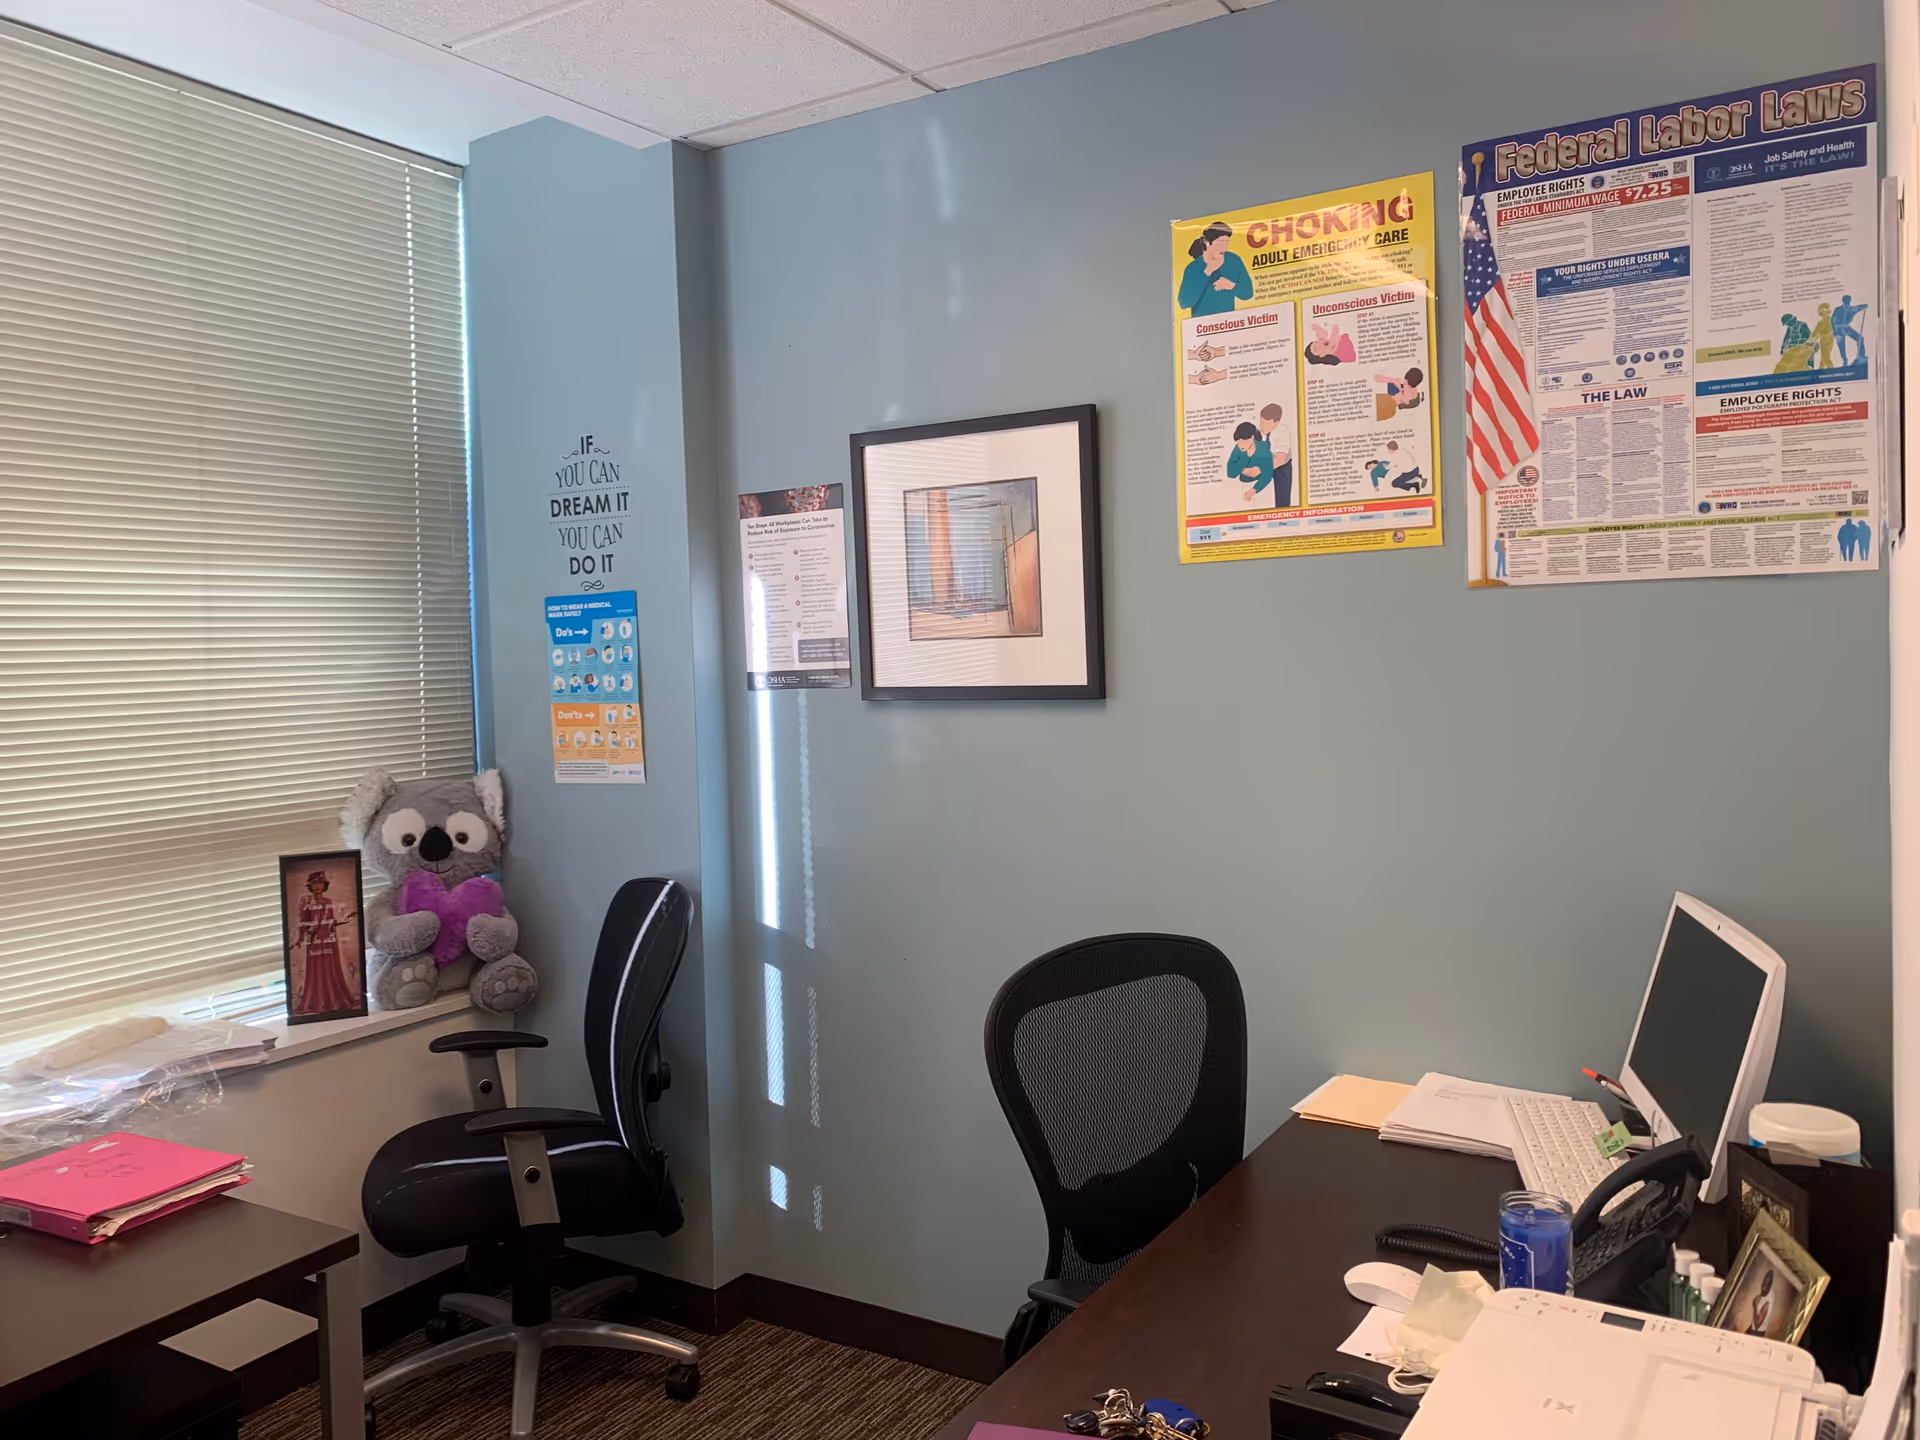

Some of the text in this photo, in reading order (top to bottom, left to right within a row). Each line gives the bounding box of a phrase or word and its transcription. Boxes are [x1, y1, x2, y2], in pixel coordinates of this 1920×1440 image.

[1496, 117, 1630, 183] Federal
[1639, 101, 1752, 156] Labor
[1761, 79, 1866, 133] Laws
[1764, 140, 1855, 163] Job Safety and Health
[1765, 151, 1854, 173] IT'S THE LAW!
[1497, 177, 1585, 202] EMPLOYEE RIGHTS
[1625, 181, 1671, 200] $7.25
[1501, 190, 1620, 221] FEDERAL MINIMUM WAGE
[1246, 195, 1414, 249] CHOKING
[1252, 249, 1288, 267] ADULT
[1292, 235, 1370, 260] EMERGENCY
[1375, 228, 1409, 245] CARE
[1554, 251, 1670, 277] YOUR RIGHTS UNDER USERRA
[1312, 291, 1415, 315] Unconscious Victim
[1196, 313, 1278, 334] Conscious Victim
[1581, 386, 1647, 404] THE LAW
[1720, 387, 1842, 408] EMPLOYEE RIGHTS
[580, 435, 594, 455] IF
[555, 459, 621, 489] YOU CAN
[550, 491, 629, 517] DREAM IT
[1247, 511, 1301, 522] EMERGENCY
[1303, 504, 1365, 517] INFORMATION
[558, 522, 623, 550] YOU CAN
[570, 554, 614, 575] DO IT
[555, 626, 574, 637] Do's
[557, 709, 583, 720] Don'ts
